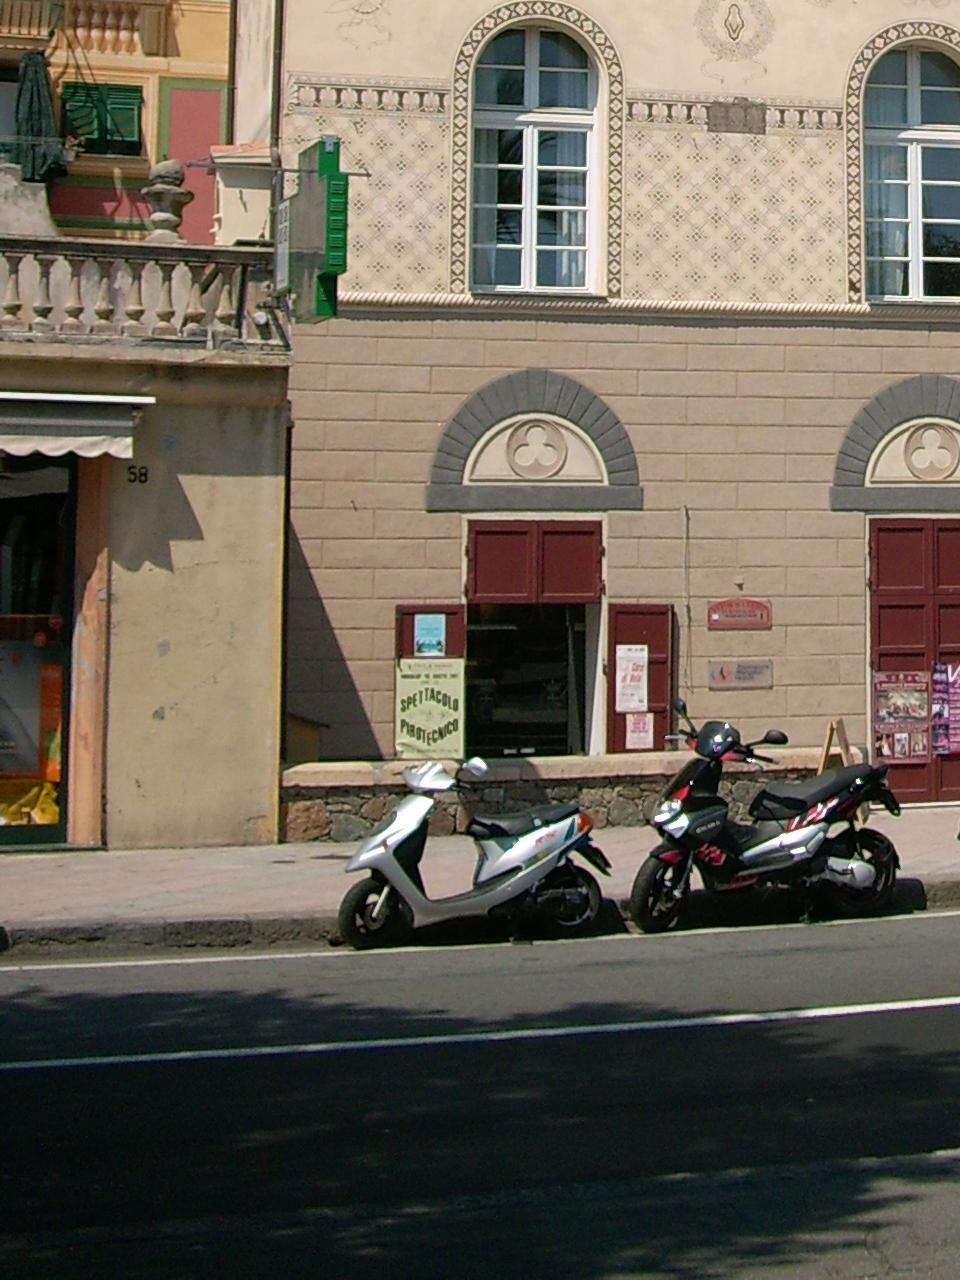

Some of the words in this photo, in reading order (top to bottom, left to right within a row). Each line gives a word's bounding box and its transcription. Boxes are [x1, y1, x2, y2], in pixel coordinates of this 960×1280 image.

[128, 465, 148, 484] 58
[400, 687, 459, 712] SPETTACOLO
[400, 719, 459, 746] PIROTECNICO
